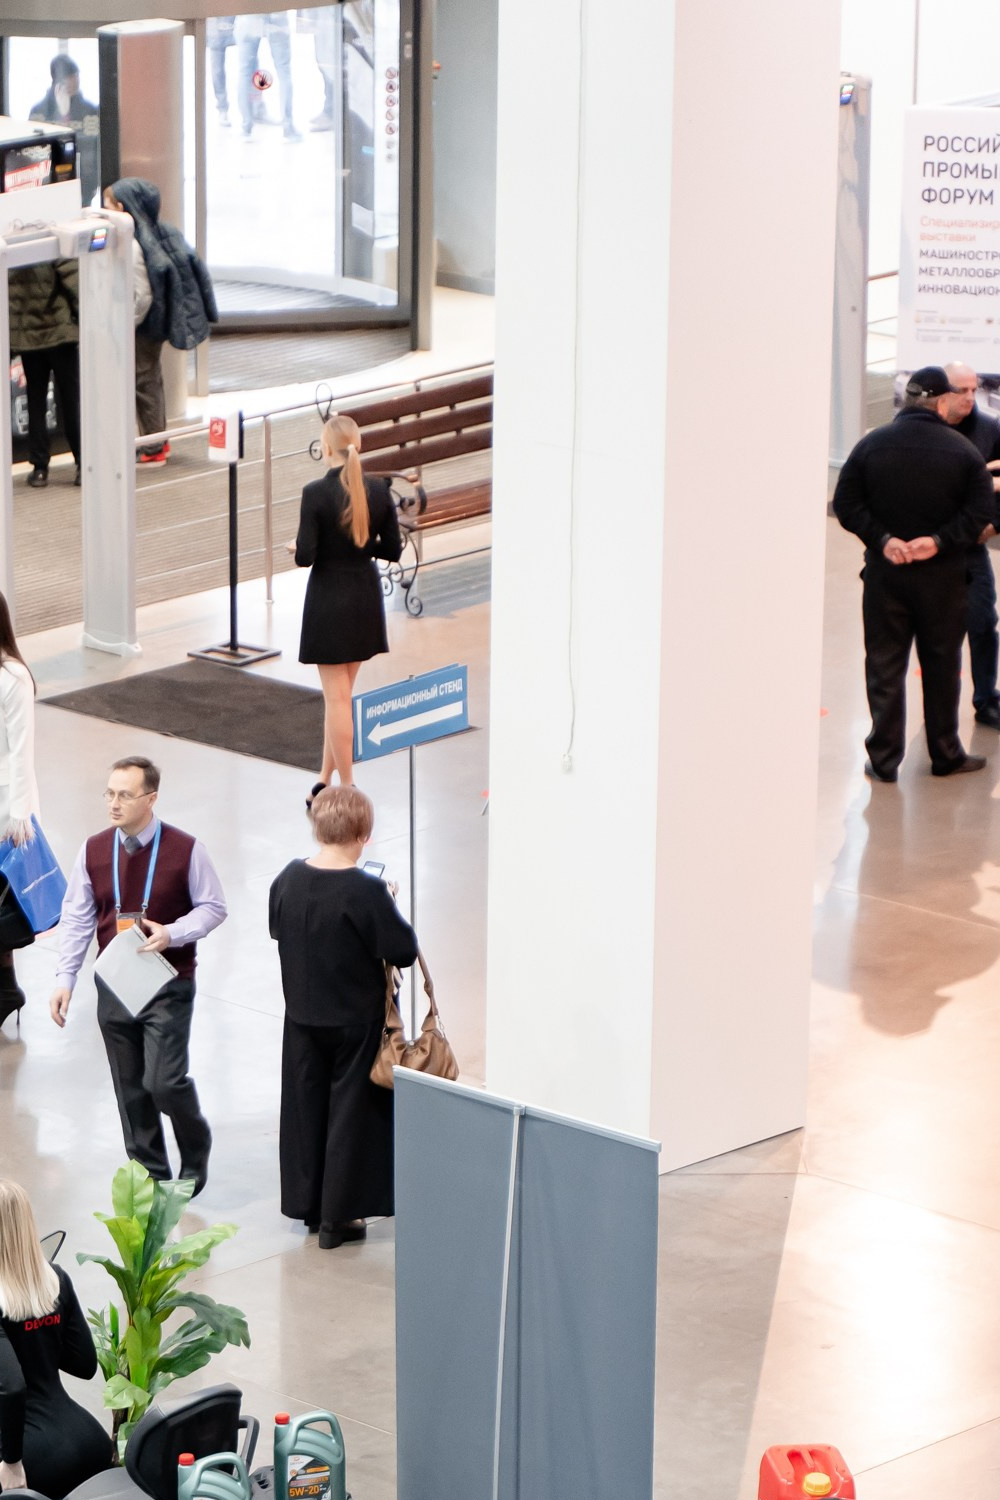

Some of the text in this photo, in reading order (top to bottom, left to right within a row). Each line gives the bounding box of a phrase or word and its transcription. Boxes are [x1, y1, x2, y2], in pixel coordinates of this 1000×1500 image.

[922, 161, 1000, 179] ПРОМЫ
[921, 187, 994, 205] ФОРУМ
[919, 249, 1000, 261] МАШИНОСТР
[366, 678, 463, 719] ИНФОРМАЦИОННЫЙ СТЕНД
[24, 1314, 61, 1331] DEVON
[289, 1485, 320, 1497] 5W-20
